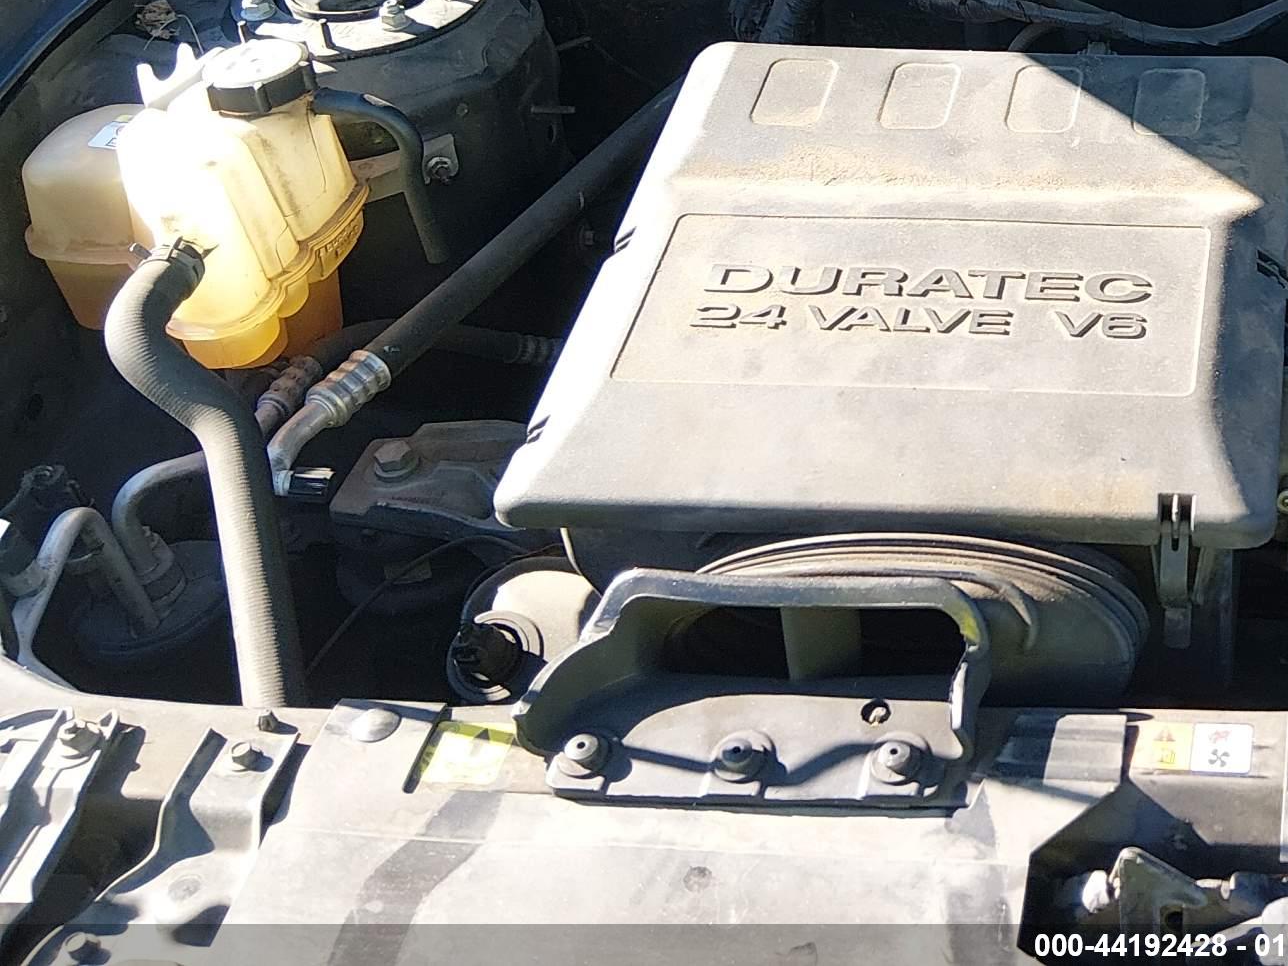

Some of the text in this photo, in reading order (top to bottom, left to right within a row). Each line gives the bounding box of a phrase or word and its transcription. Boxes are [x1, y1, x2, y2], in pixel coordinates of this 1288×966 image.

[703, 263, 1153, 304] DURATEC
[690, 303, 1149, 340] 24 VALVE V6
